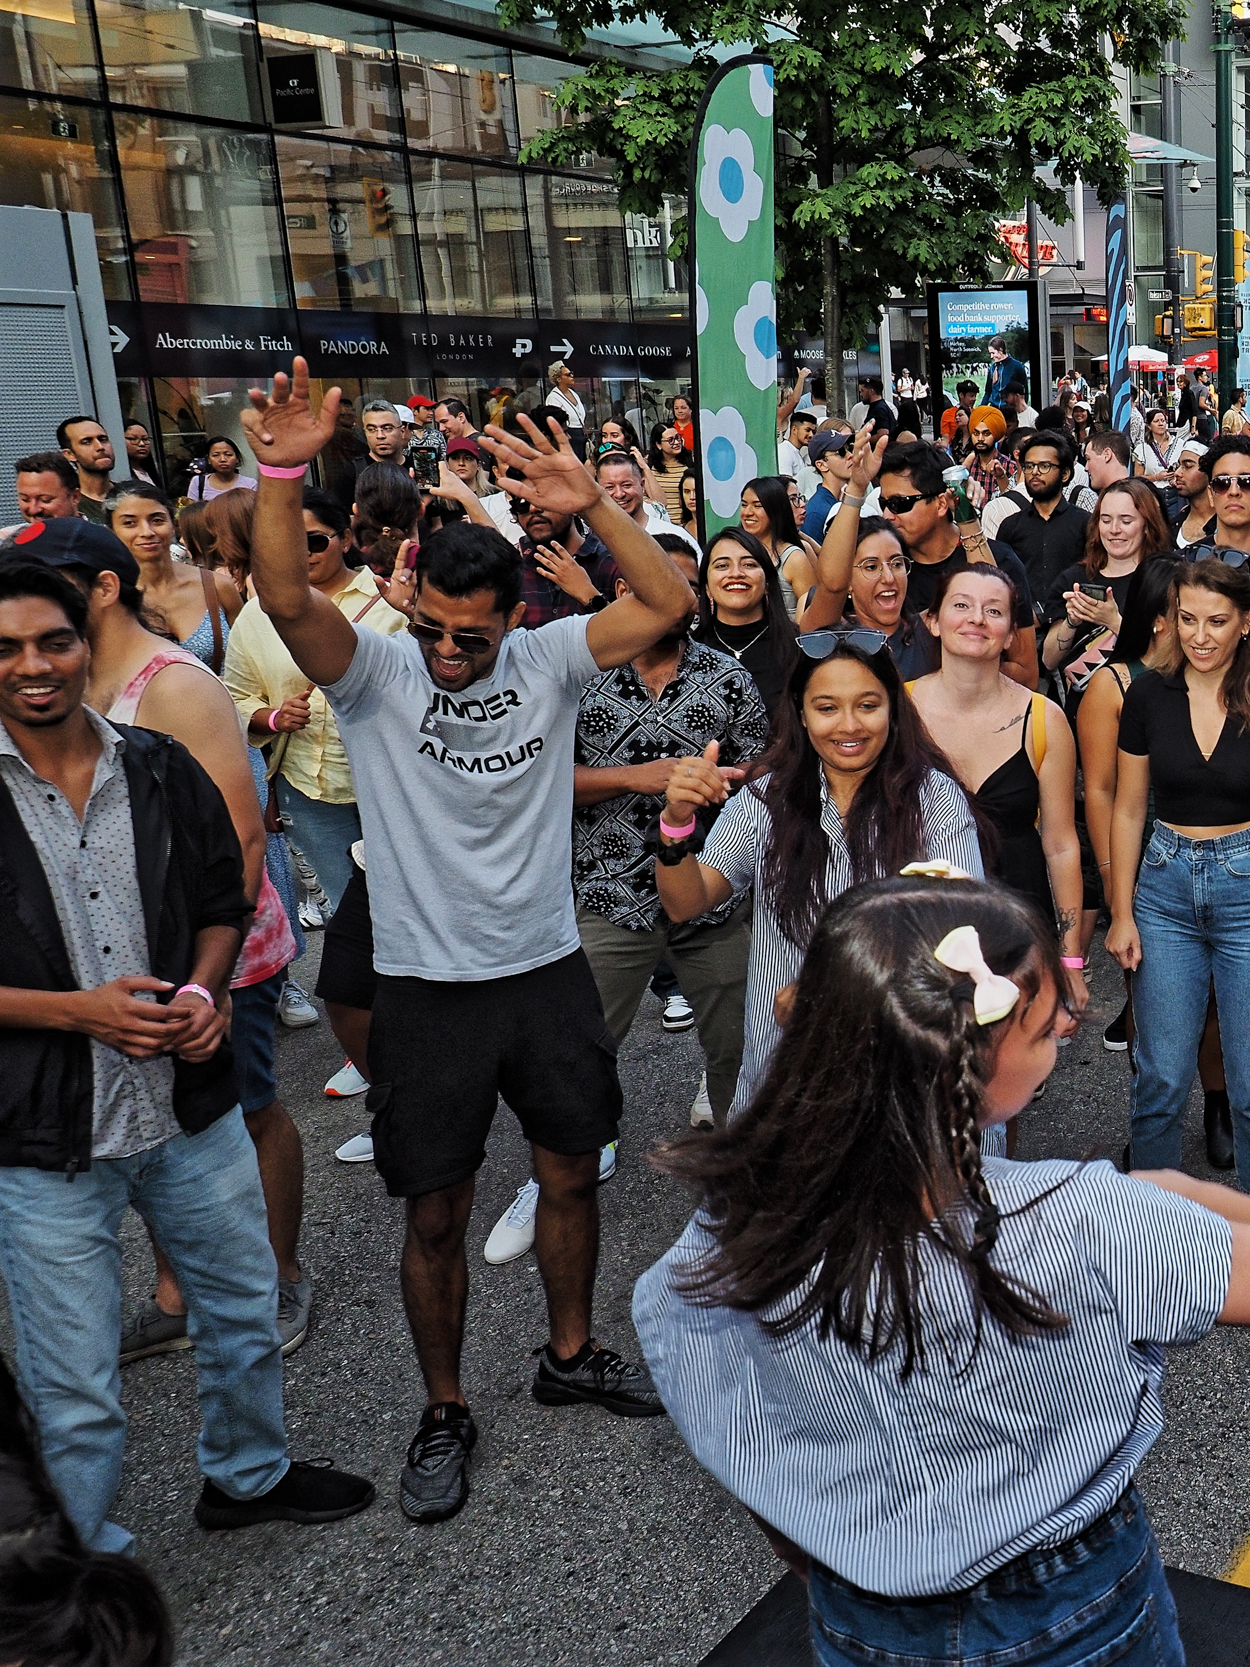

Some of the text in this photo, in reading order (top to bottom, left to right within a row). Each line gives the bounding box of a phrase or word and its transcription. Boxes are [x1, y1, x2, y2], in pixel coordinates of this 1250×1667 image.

[275, 87, 315, 97] Pacific Centre
[947, 302, 990, 312] Competitive
[947, 313, 965, 322] food
[965, 313, 984, 322] bank
[948, 324, 993, 335] dairy farmer.
[155, 332, 293, 351] Abercrombie & Fitch
[320, 336, 389, 355] PANDORA
[411, 332, 494, 347] TED BAKER
[590, 344, 635, 356] CANADA
[637, 345, 673, 357] GOOSE
[801, 350, 824, 359] MOOSE
[417, 736, 544, 774] ARMOUR
